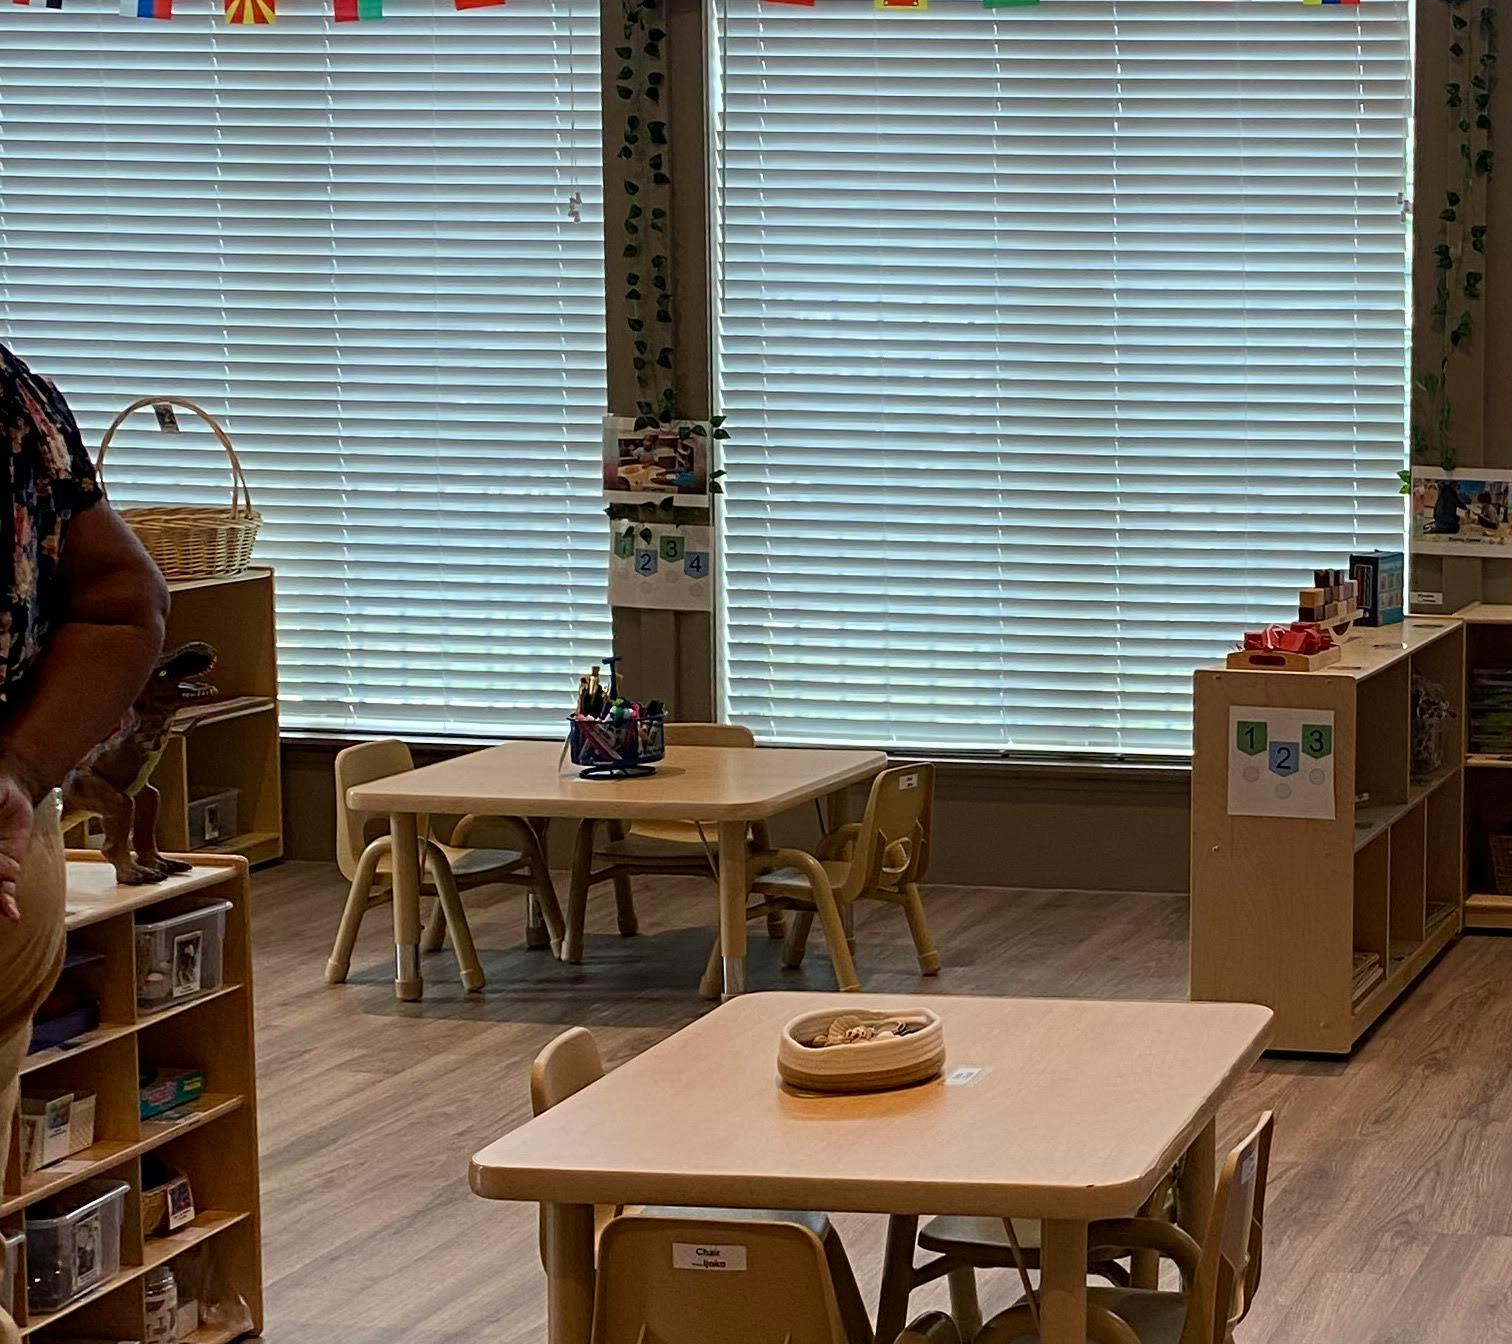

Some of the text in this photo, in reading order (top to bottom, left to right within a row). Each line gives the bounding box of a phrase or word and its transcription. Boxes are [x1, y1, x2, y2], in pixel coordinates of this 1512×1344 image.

[640, 553, 652, 572] 2
[665, 539, 677, 558] 3
[688, 554, 702, 573] 4
[1244, 726, 1325, 770] 1 2 3
[695, 1247, 720, 1257] Chair
